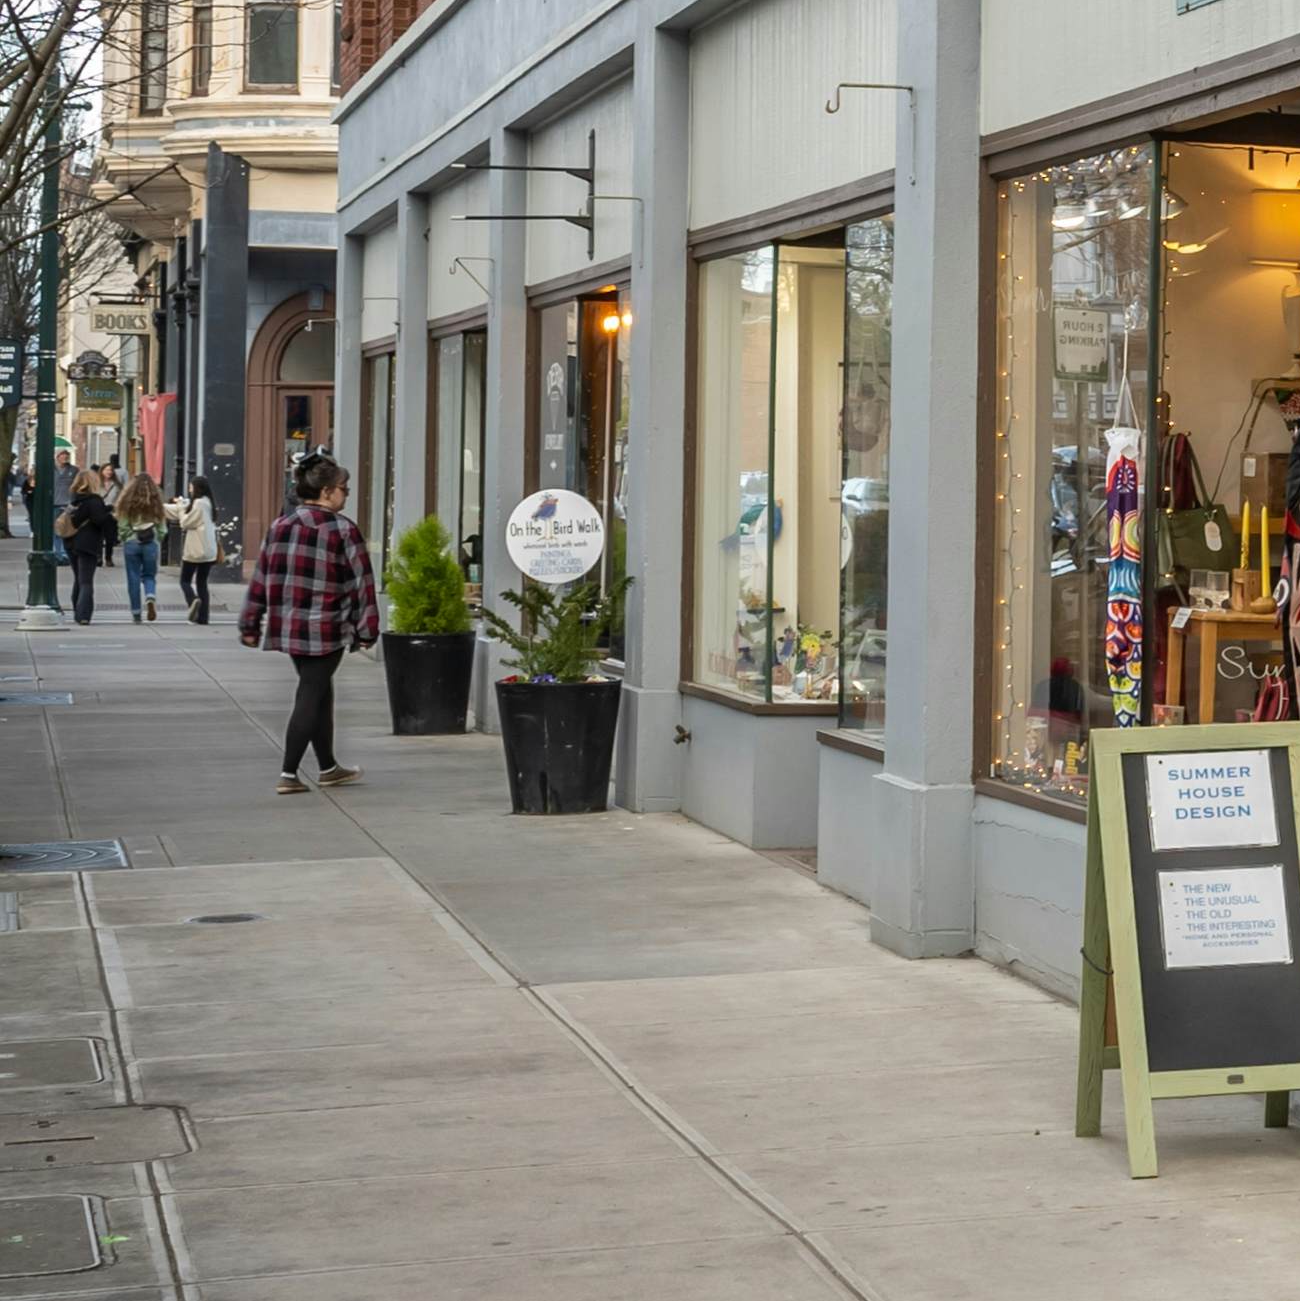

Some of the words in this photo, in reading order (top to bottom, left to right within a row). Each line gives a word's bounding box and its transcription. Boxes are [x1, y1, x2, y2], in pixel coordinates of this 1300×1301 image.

[94, 313, 147, 330] BOOKS
[510, 523, 524, 537] On
[526, 521, 542, 536] the
[553, 519, 573, 534] Bird
[576, 517, 601, 534] Walk
[1167, 765, 1252, 782] SUMMER
[1178, 784, 1246, 801] HOUSE
[1174, 803, 1253, 821] DESIGN
[1183, 884, 1204, 894] THE
[1206, 883, 1232, 893] NEW
[1184, 897, 1206, 907] THE
[1208, 895, 1261, 907] UNUSUAL
[1186, 910, 1208, 920] THE
[1209, 909, 1232, 919] OLD
[1187, 923, 1208, 933] THE
[1209, 919, 1277, 932] INTERESTING
[1230, 931, 1275, 939] PERSONAL
